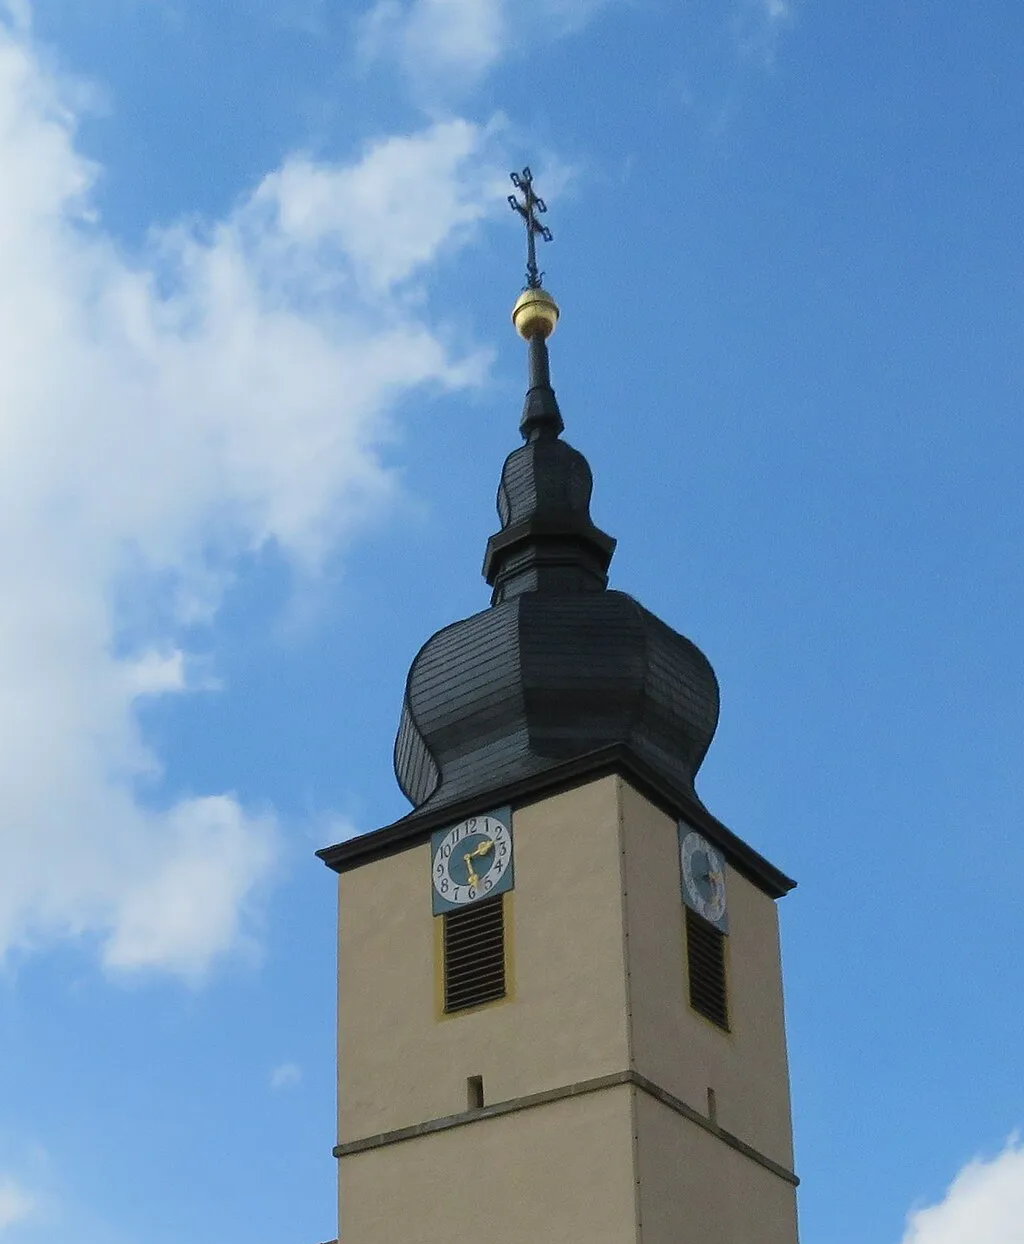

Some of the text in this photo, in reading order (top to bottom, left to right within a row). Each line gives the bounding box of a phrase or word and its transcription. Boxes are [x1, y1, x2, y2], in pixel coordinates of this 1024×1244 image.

[465, 818, 477, 835] 12
[494, 826, 502, 841] 2
[452, 828, 459, 844] 11
[440, 844, 451, 859] 10
[499, 841, 507, 856] 3
[436, 864, 444, 878] 9
[493, 859, 503, 873] 4
[440, 878, 448, 893] 8
[484, 876, 493, 890] 5
[453, 886, 460, 900] 7
[468, 884, 476, 899] 6
